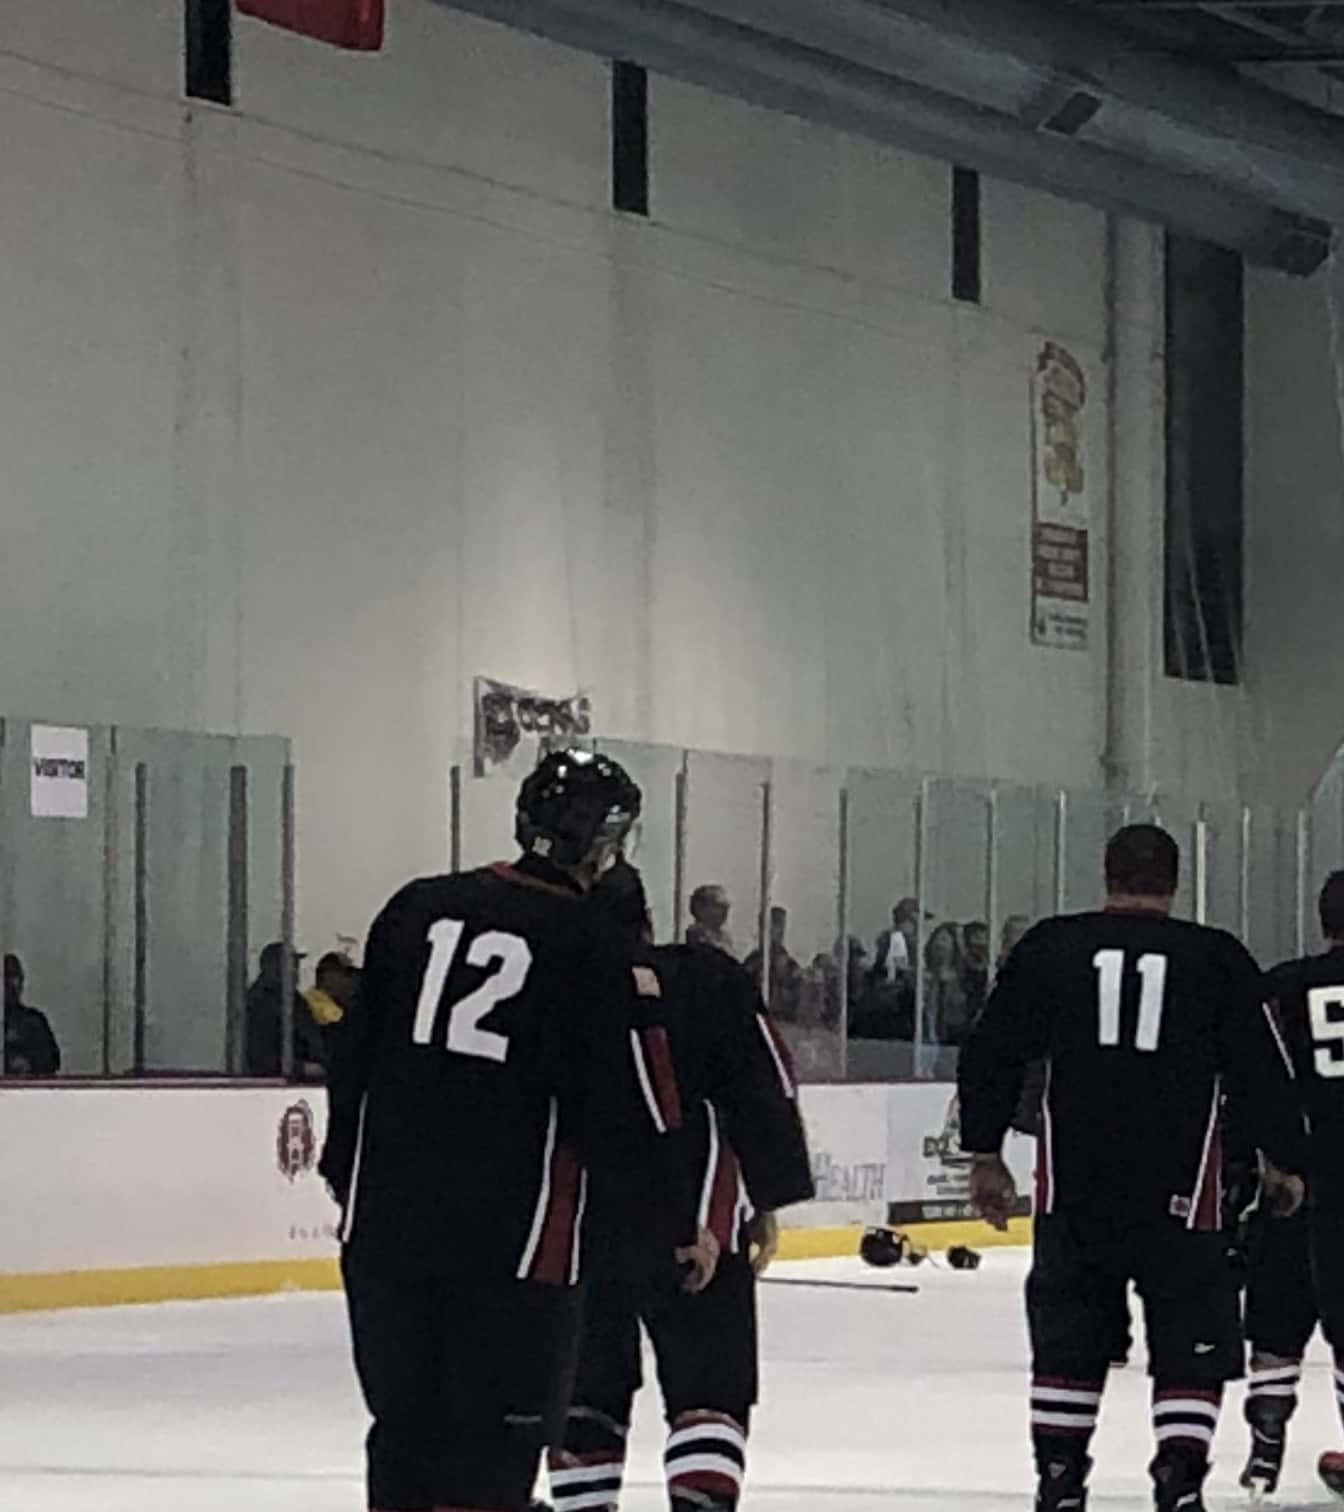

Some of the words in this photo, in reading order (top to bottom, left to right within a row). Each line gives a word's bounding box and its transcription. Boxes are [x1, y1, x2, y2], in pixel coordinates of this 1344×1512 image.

[34, 758, 85, 778] VISITOR
[412, 917, 533, 1063] 12
[1093, 949, 1167, 1051] 11
